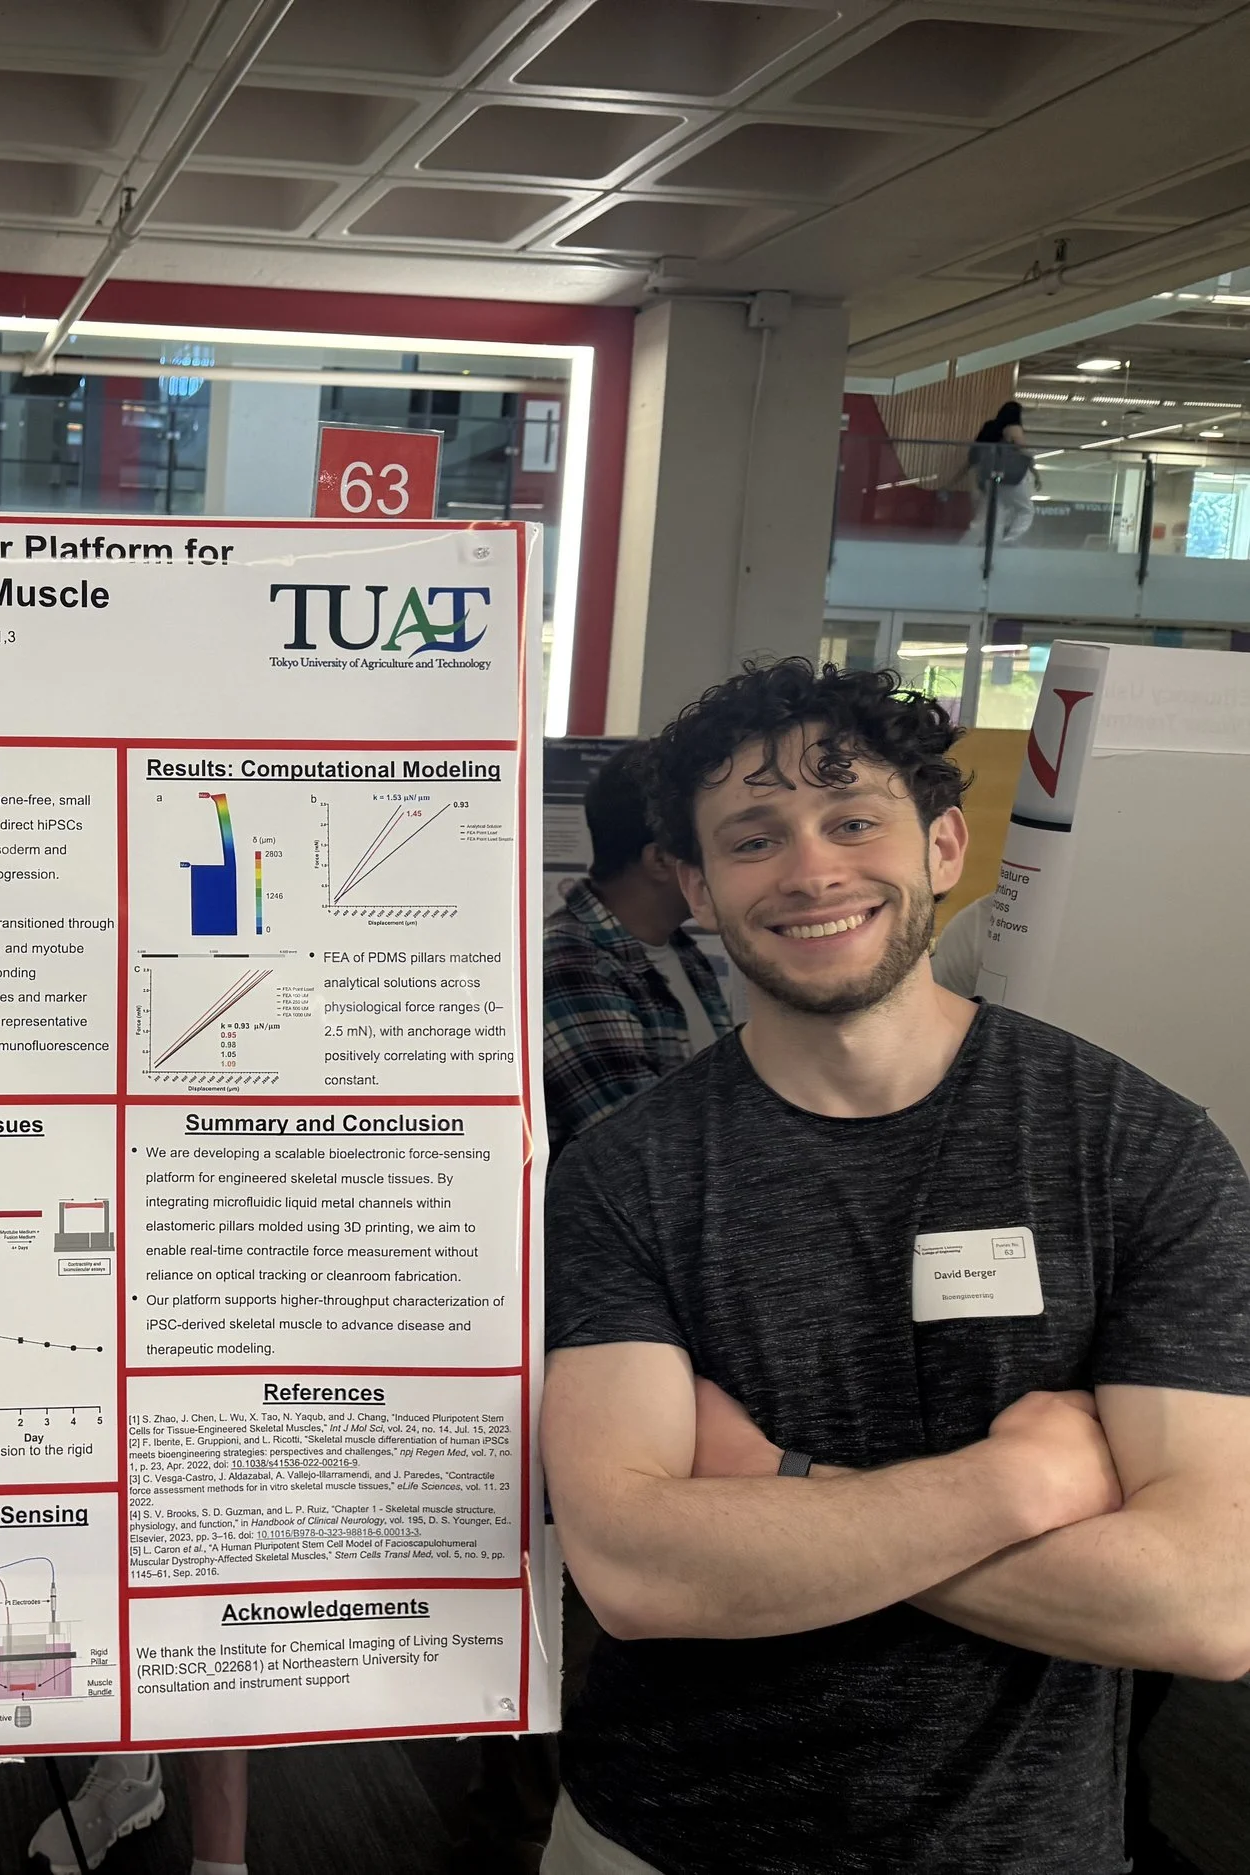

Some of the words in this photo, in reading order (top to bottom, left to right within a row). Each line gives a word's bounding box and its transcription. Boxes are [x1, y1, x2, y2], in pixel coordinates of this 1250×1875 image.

[340, 460, 410, 515] 63
[25, 534, 174, 564] Platform
[185, 538, 234, 566] for
[269, 583, 491, 660] TUAT
[269, 656, 299, 670] Tokyo
[300, 657, 348, 670] University
[349, 658, 361, 669] of
[360, 658, 414, 671] Agriculture
[415, 659, 434, 669] and
[435, 658, 492, 671] Technology
[147, 758, 233, 779] Results:
[241, 758, 395, 780] Computational
[402, 759, 501, 780] Modeling
[59, 793, 91, 806] small
[996, 917, 1029, 933] shows
[185, 1113, 289, 1137] Summary
[295, 1113, 335, 1133] and
[342, 1113, 464, 1132] Conclusion
[145, 1244, 187, 1257] enable
[190, 1244, 244, 1257] real-time
[246, 1245, 310, 1258] contractile
[312, 1244, 344, 1257] force
[347, 1245, 432, 1258] measurement
[434, 1244, 479, 1258] without
[934, 1270, 961, 1280] David
[964, 1269, 996, 1279] Berger
[263, 1383, 385, 1402] References
[24, 1432, 44, 1445] Day
[0, 1503, 88, 1530] Sensing
[130, 1568, 171, 1580] 1145–61,
[172, 1567, 194, 1579] Sep.
[195, 1566, 220, 1578] 2016.
[222, 1599, 430, 1624] Acknowledgements
